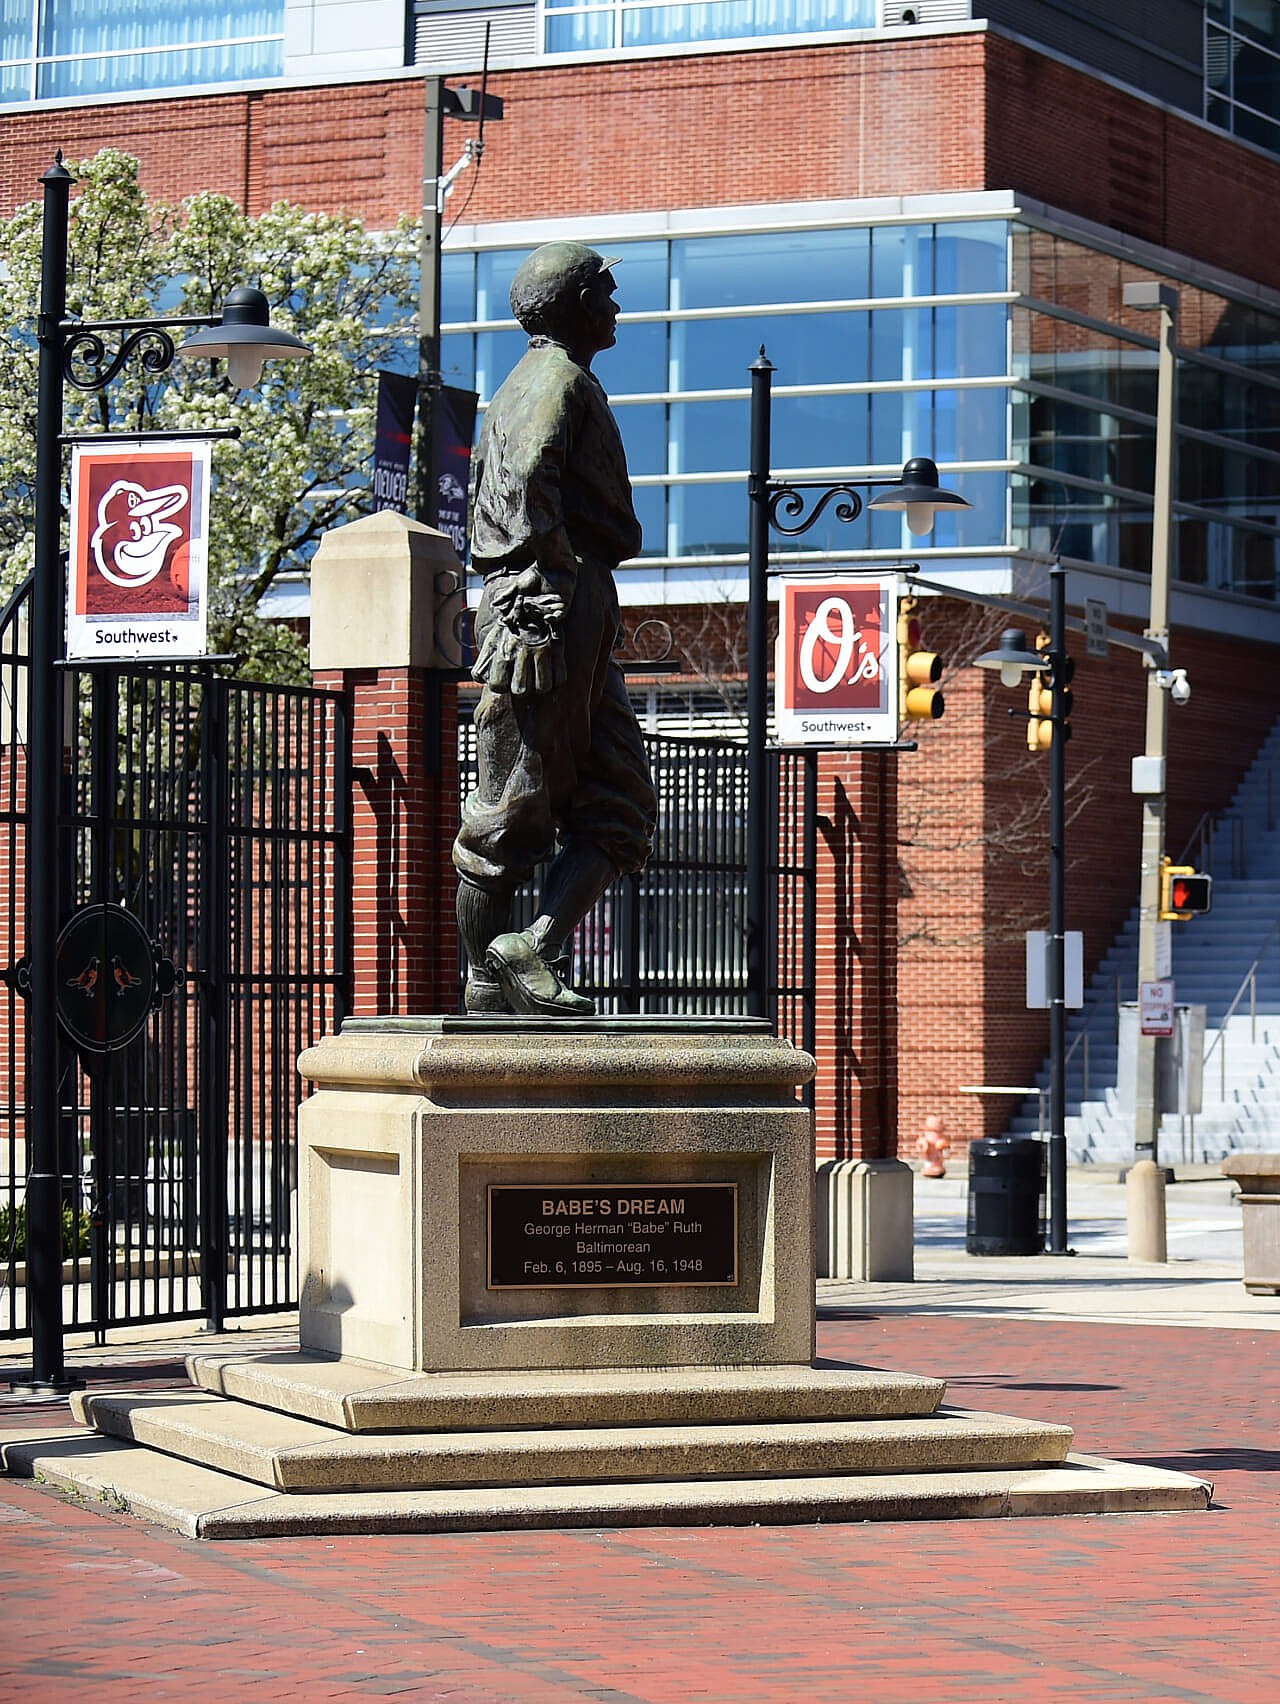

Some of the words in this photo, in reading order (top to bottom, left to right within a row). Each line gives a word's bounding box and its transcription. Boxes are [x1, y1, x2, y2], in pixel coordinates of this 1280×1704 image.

[95, 628, 171, 644] Southwest
[800, 597, 879, 694] O's
[801, 721, 865, 732] Southwest
[542, 1199, 612, 1216] BABE’S
[617, 1199, 685, 1215] DREAM
[524, 1222, 571, 1238] George
[575, 1222, 624, 1235] Herman
[627, 1221, 670, 1234] “Babe”
[673, 1221, 702, 1233] Ruth
[576, 1241, 651, 1254] Baltimorean
[524, 1260, 552, 1274] Feb.
[555, 1260, 567, 1275] 6,
[572, 1260, 602, 1273] 1895
[616, 1259, 645, 1275] Aug.
[649, 1259, 668, 1274] 16,
[672, 1259, 703, 1272] 1948
